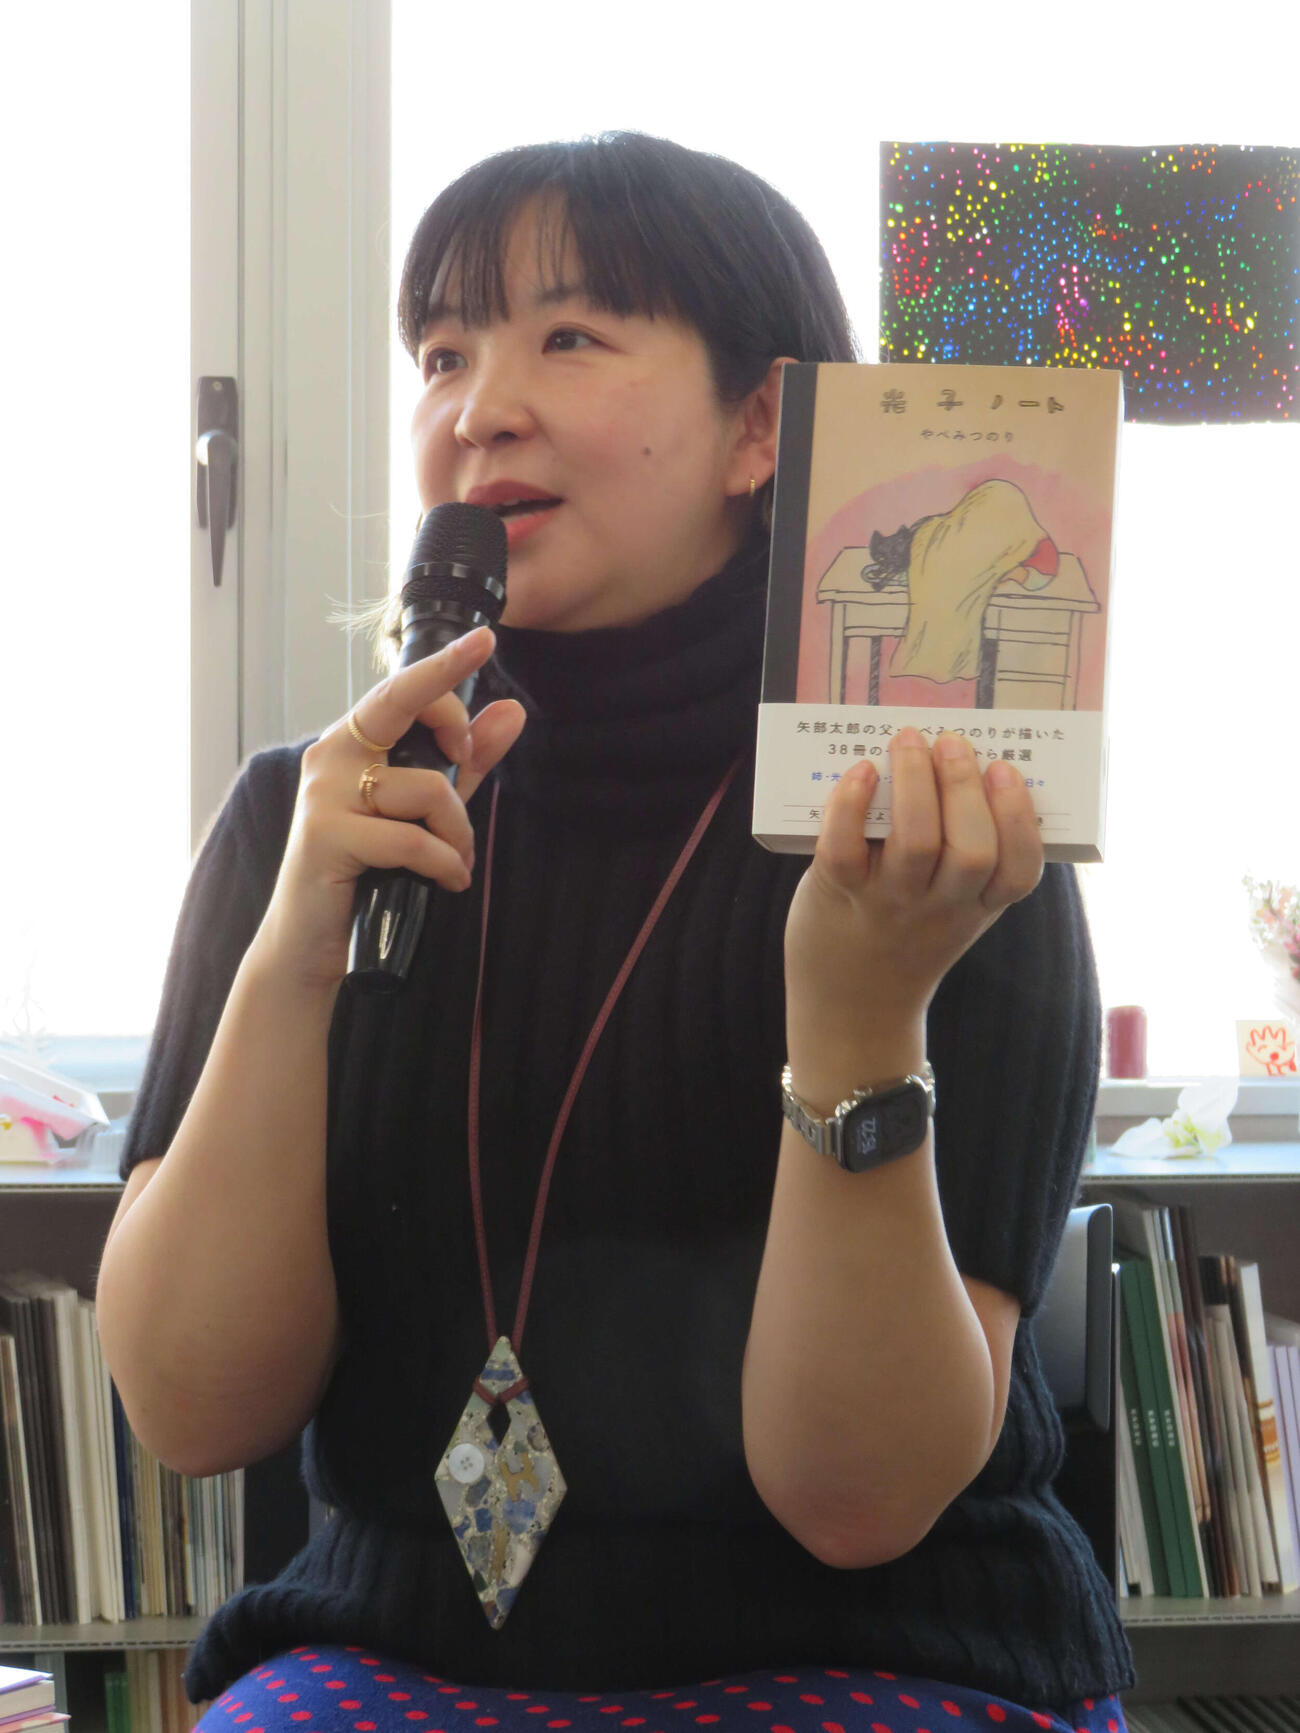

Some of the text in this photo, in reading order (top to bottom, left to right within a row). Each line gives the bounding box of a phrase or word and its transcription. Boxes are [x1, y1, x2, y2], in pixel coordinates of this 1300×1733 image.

[920, 429, 1014, 442] やべみつのり
